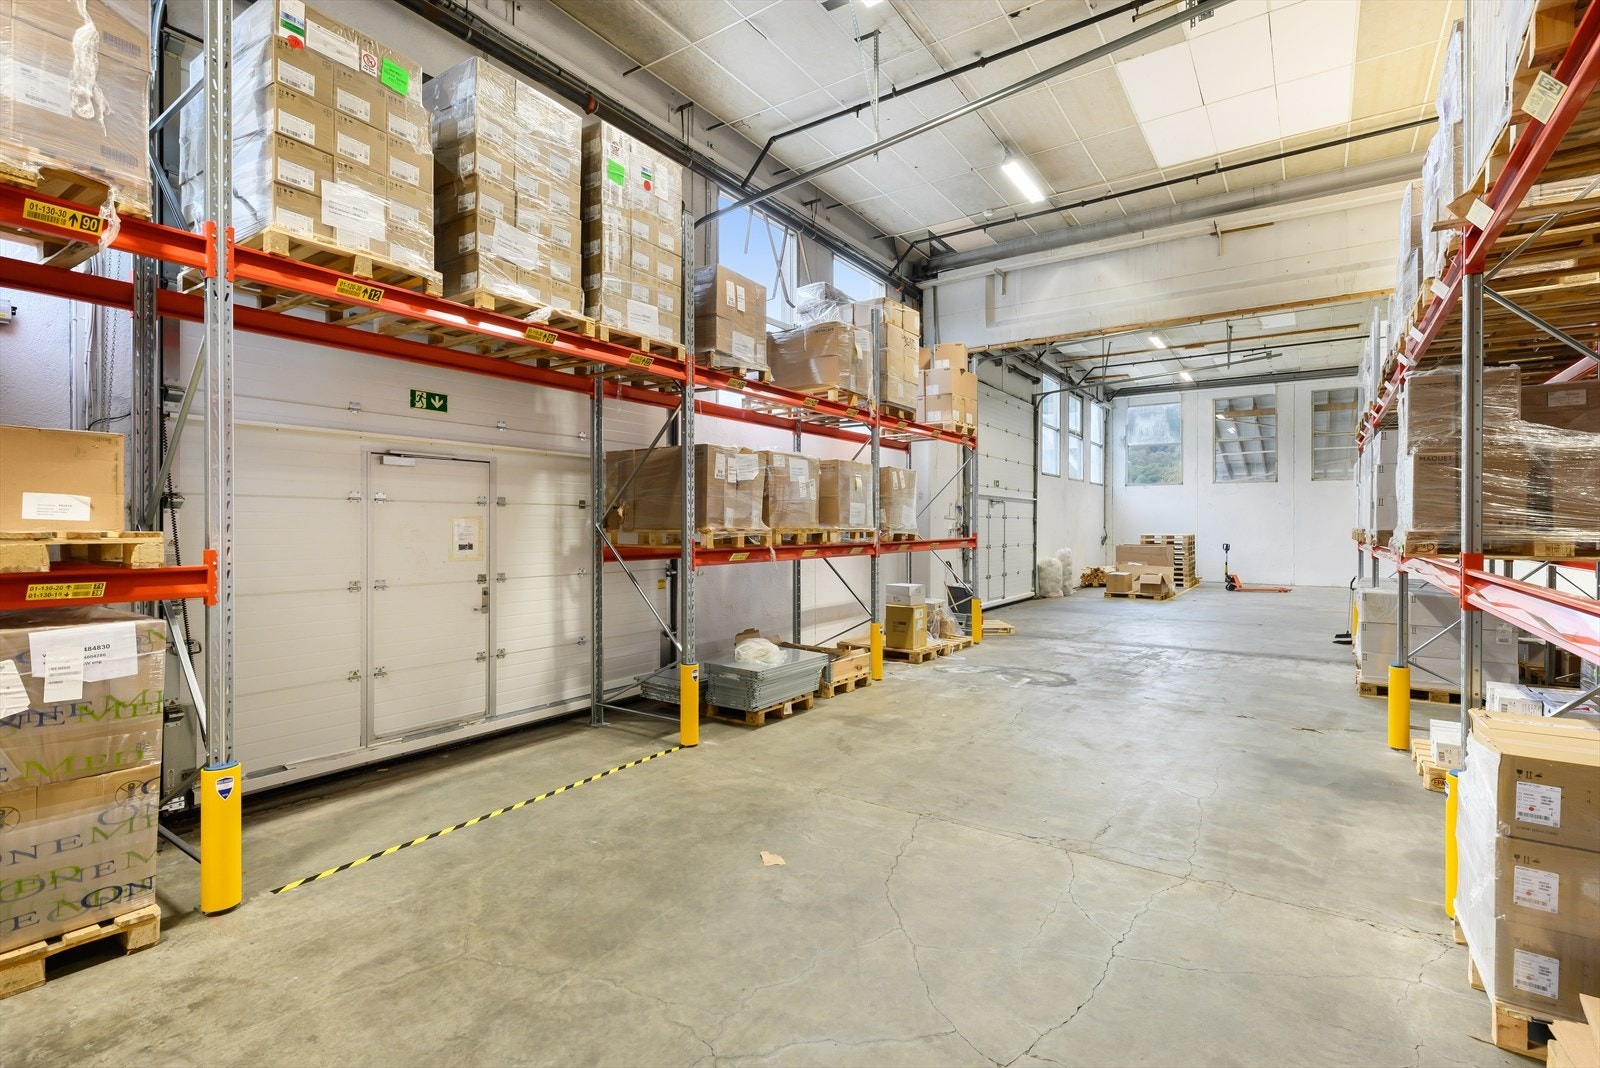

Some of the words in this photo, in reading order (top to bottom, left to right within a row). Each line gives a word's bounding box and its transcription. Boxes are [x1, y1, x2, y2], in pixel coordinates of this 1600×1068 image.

[29, 202, 67, 219] 01-130-30
[82, 217, 98, 231] 90
[370, 290, 381, 301] 12
